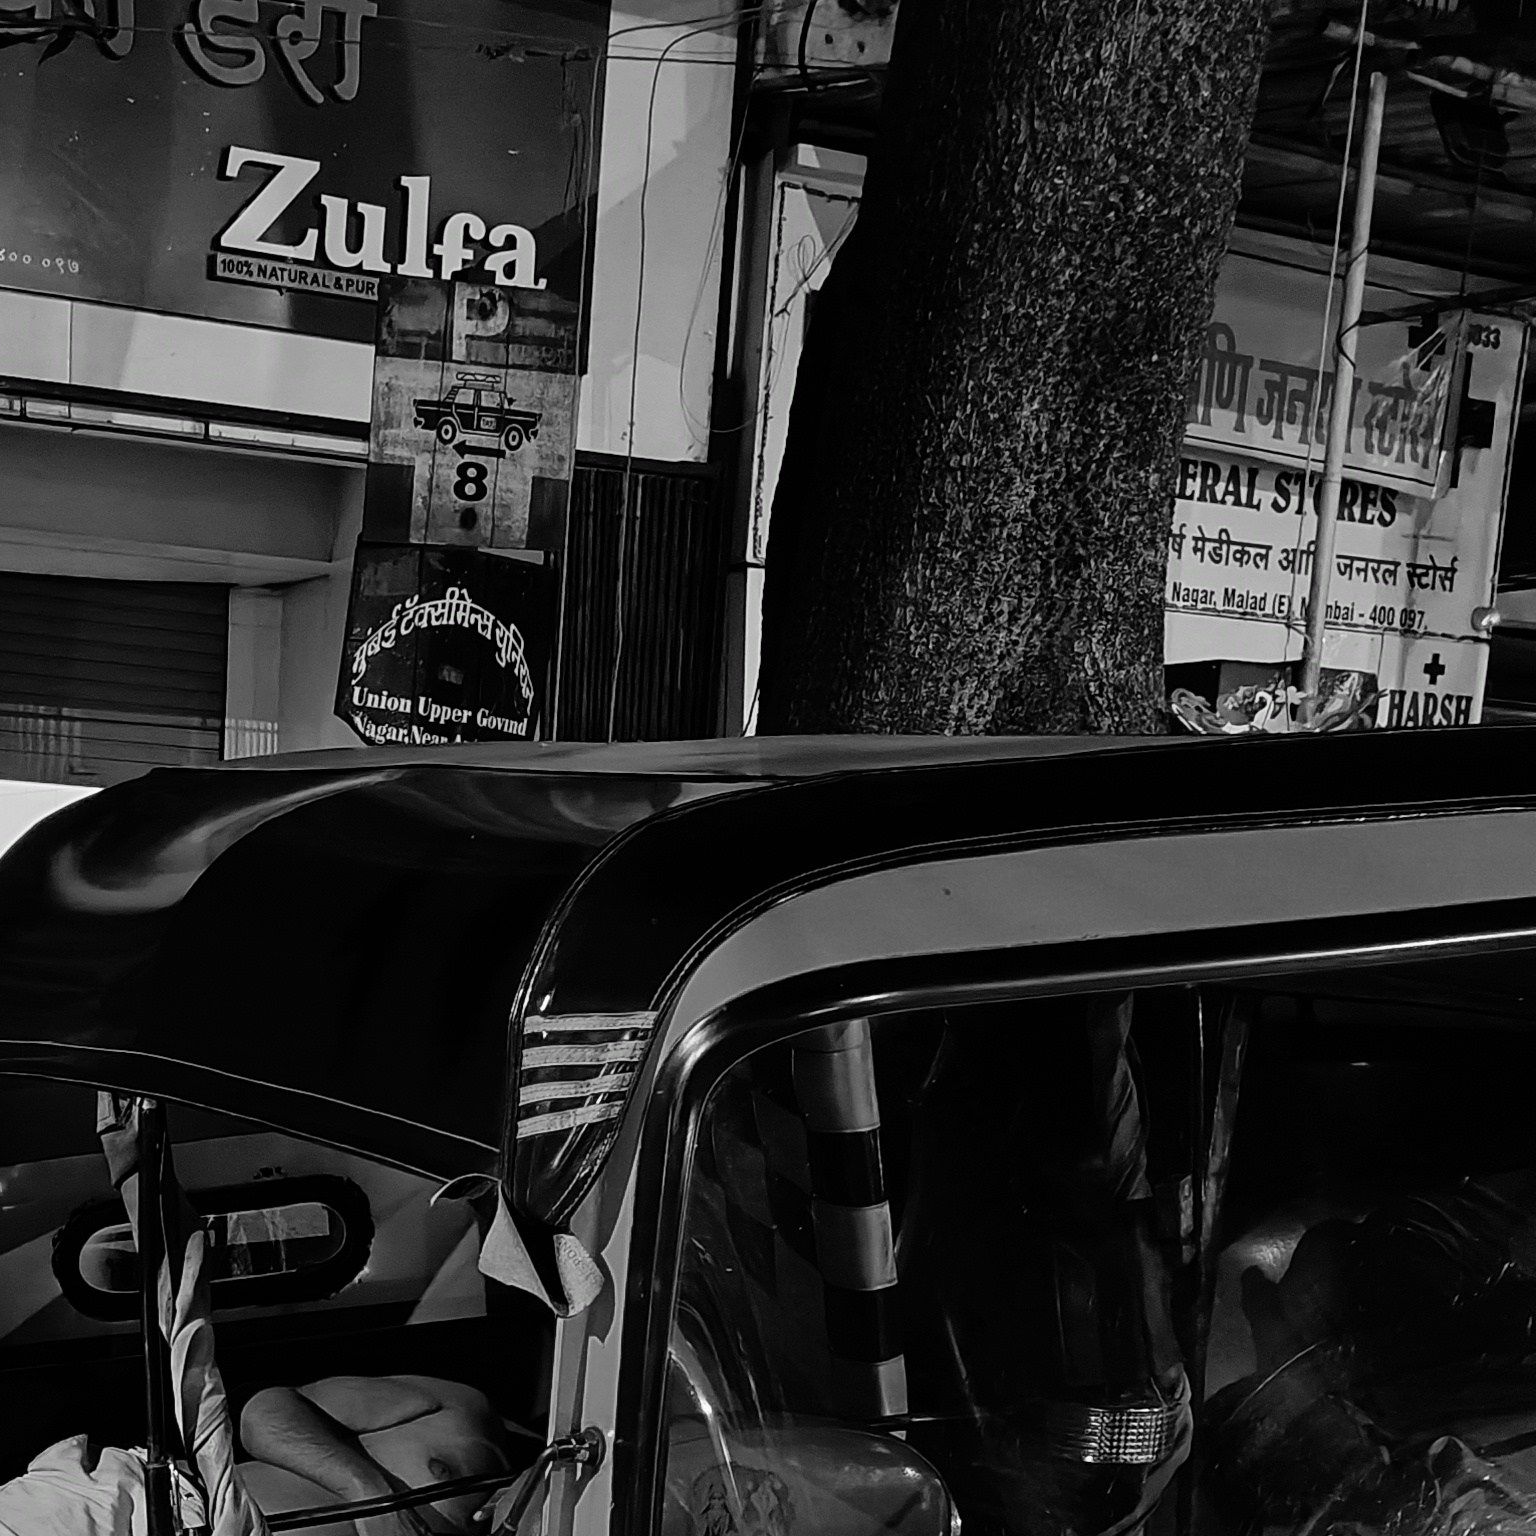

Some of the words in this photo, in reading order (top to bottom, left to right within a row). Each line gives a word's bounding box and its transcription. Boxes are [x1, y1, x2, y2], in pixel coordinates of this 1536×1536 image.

[221, 145, 547, 290] Zulfa
[221, 257, 253, 276] 100%
[257, 263, 331, 288] NATURAL
[453, 462, 488, 502] 8
[1192, 525, 1272, 571] मेडीकल
[1336, 555, 1400, 586] जनरल
[1223, 587, 1267, 612] Malad
[1369, 605, 1395, 626] 400
[352, 686, 411, 713] Union
[418, 696, 472, 724] Upper
[476, 708, 528, 737] Govind
[1387, 689, 1473, 728] HARSH
